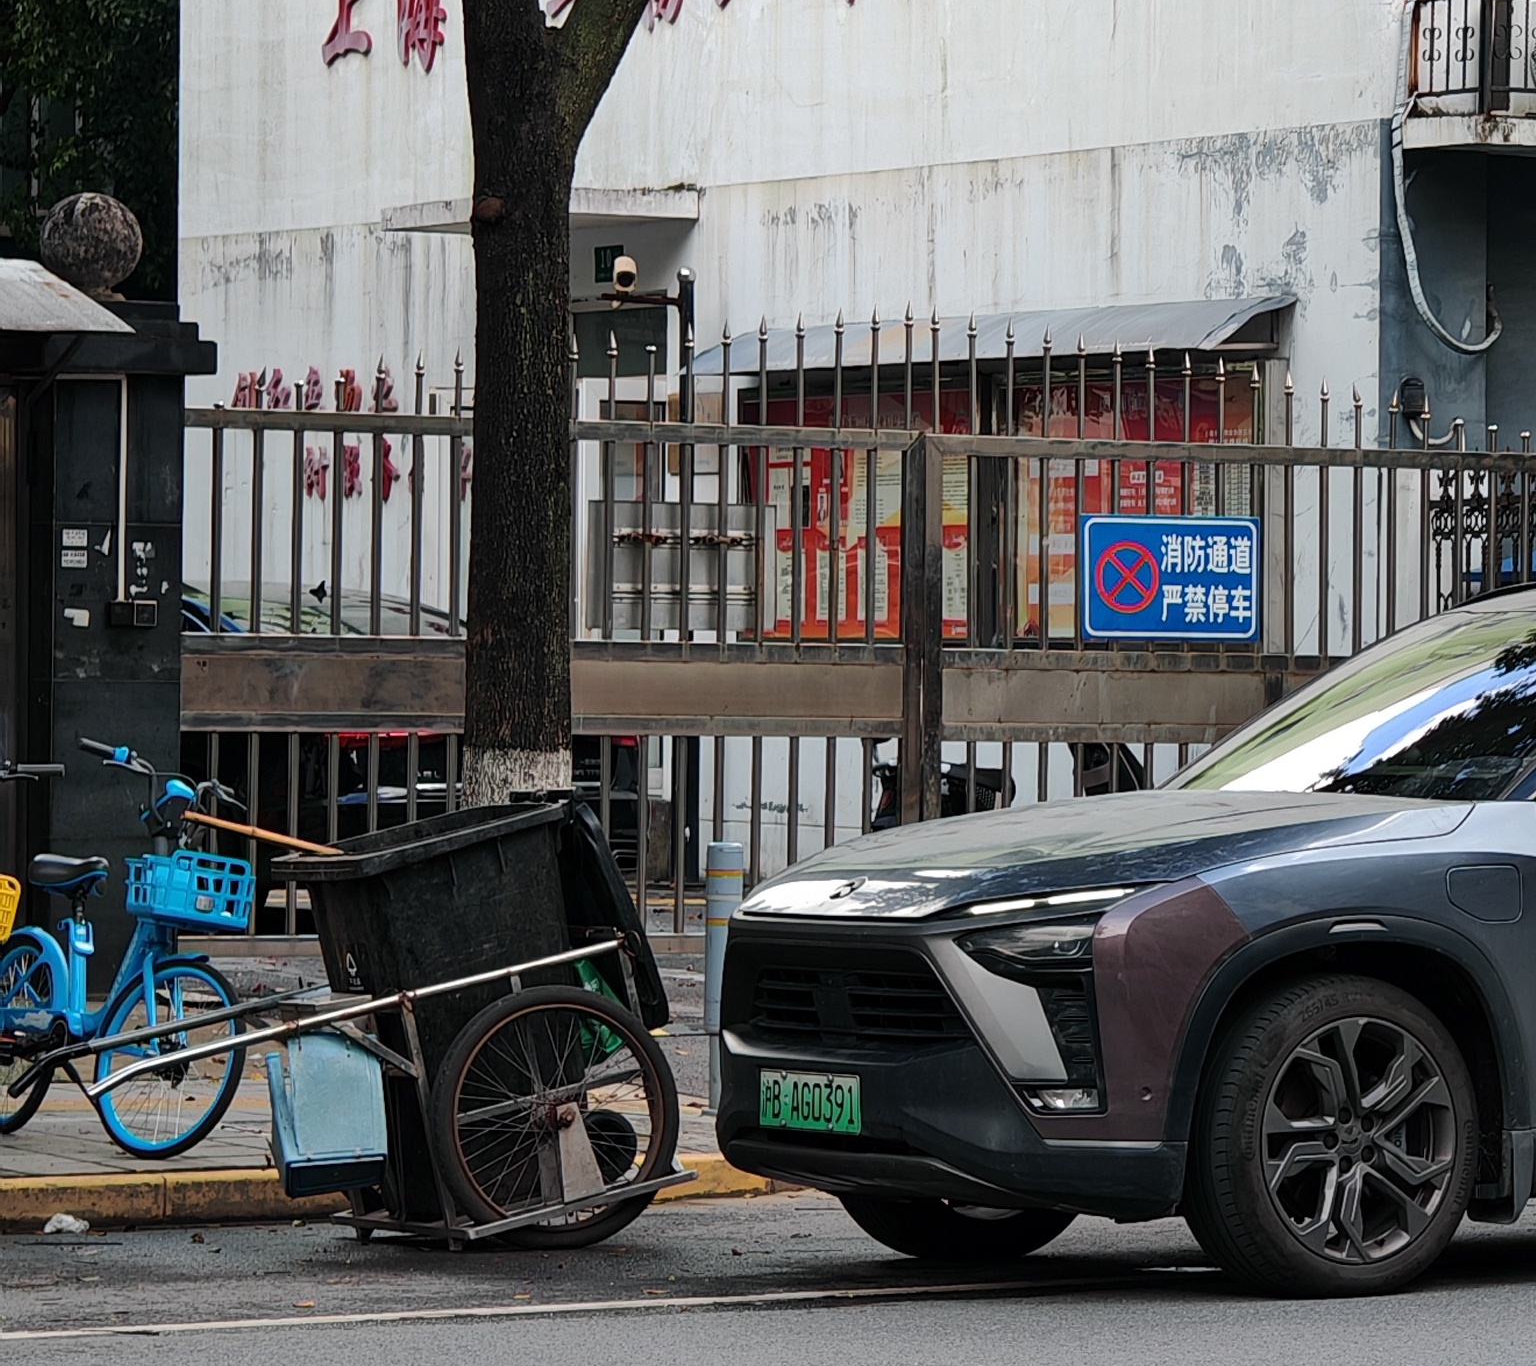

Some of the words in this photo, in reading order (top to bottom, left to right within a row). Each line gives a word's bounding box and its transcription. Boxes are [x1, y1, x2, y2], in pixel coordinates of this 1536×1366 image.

[1160, 533, 1252, 574] 消防通道
[1160, 584, 1252, 624] 严禁停车
